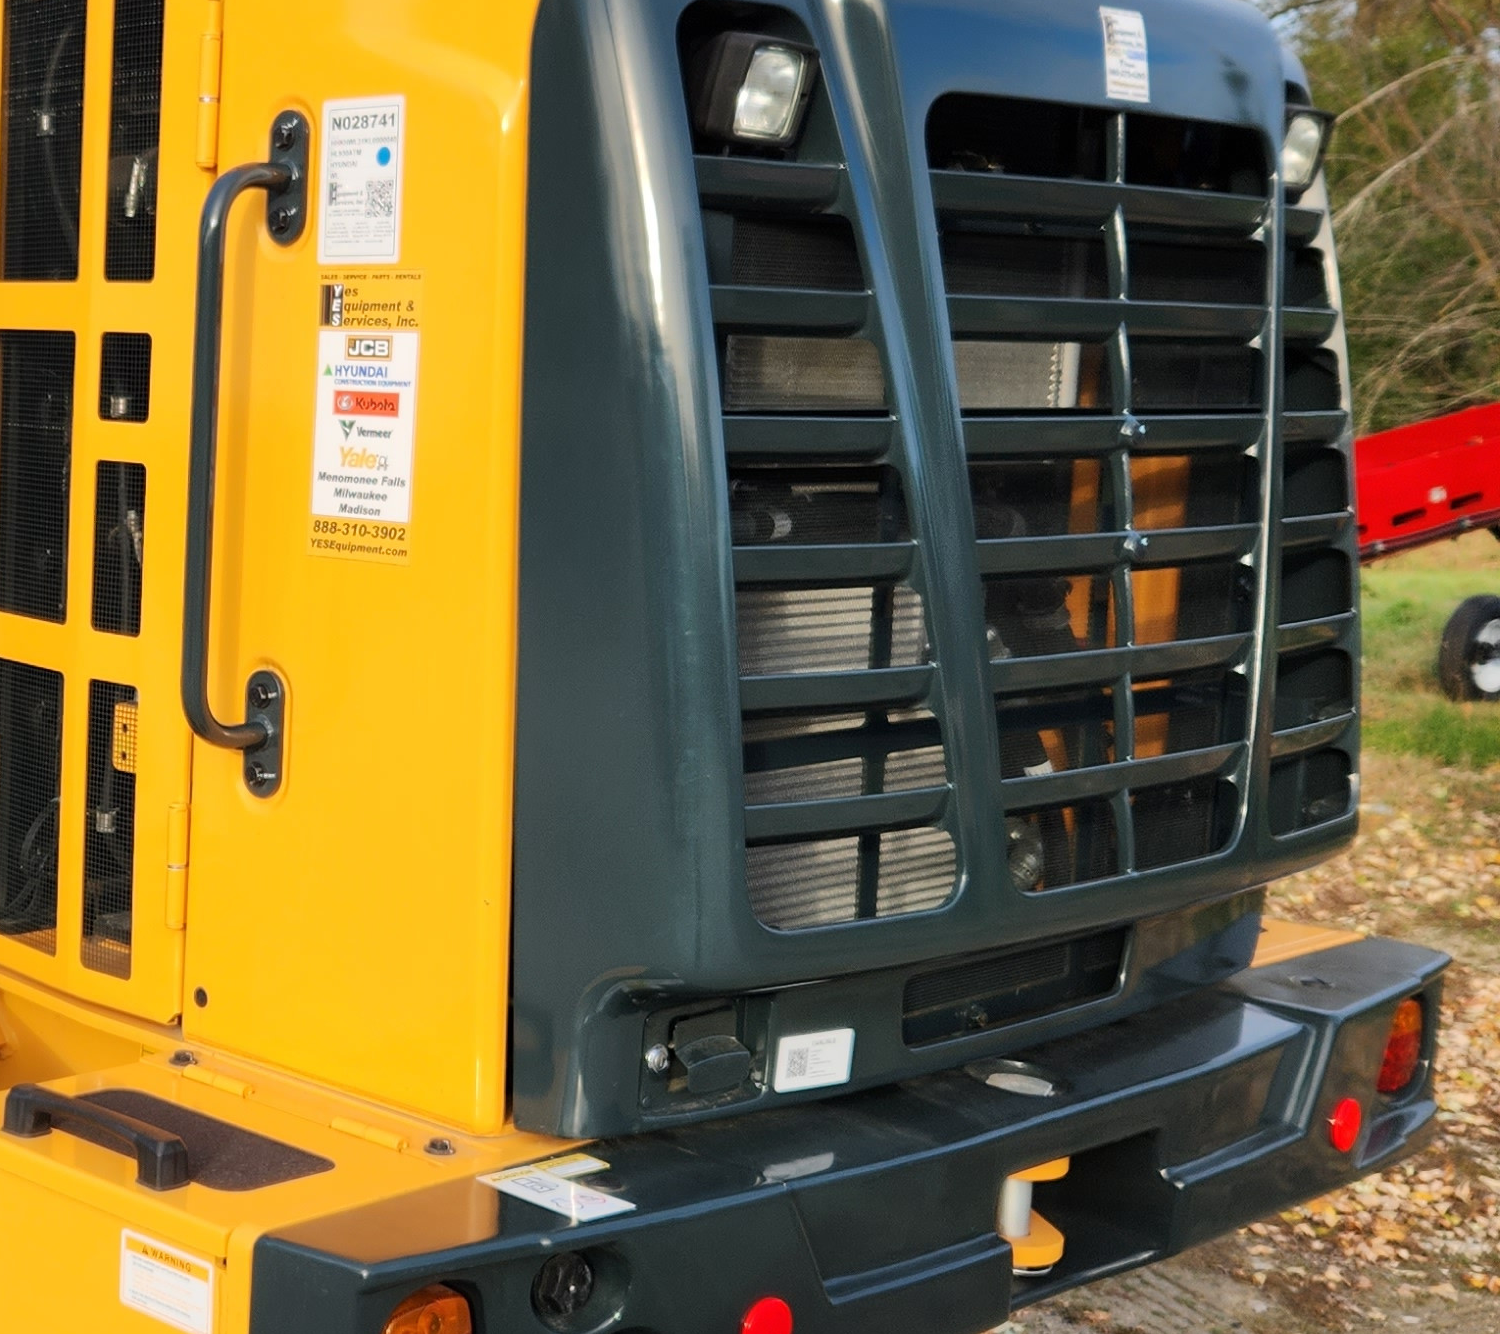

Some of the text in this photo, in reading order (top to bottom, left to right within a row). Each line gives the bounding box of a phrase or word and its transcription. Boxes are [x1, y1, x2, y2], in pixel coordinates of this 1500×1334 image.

[331, 112, 396, 131] N028741
[396, 315, 419, 327] Inc.
[348, 339, 389, 356] JCB
[334, 365, 388, 378] HYUNDAI
[334, 378, 377, 386] CONSTRUCTION
[355, 397, 396, 411] Kubota
[356, 427, 393, 439] Vermeer
[339, 446, 377, 470] Yale
[317, 471, 406, 487] Menomonee Falls
[333, 488, 388, 501] Milwaukee
[338, 503, 381, 516] Madison
[313, 520, 406, 541] 888-310-3902
[310, 538, 408, 557] YESEquipment.com
[151, 1247, 192, 1272] WARNING
